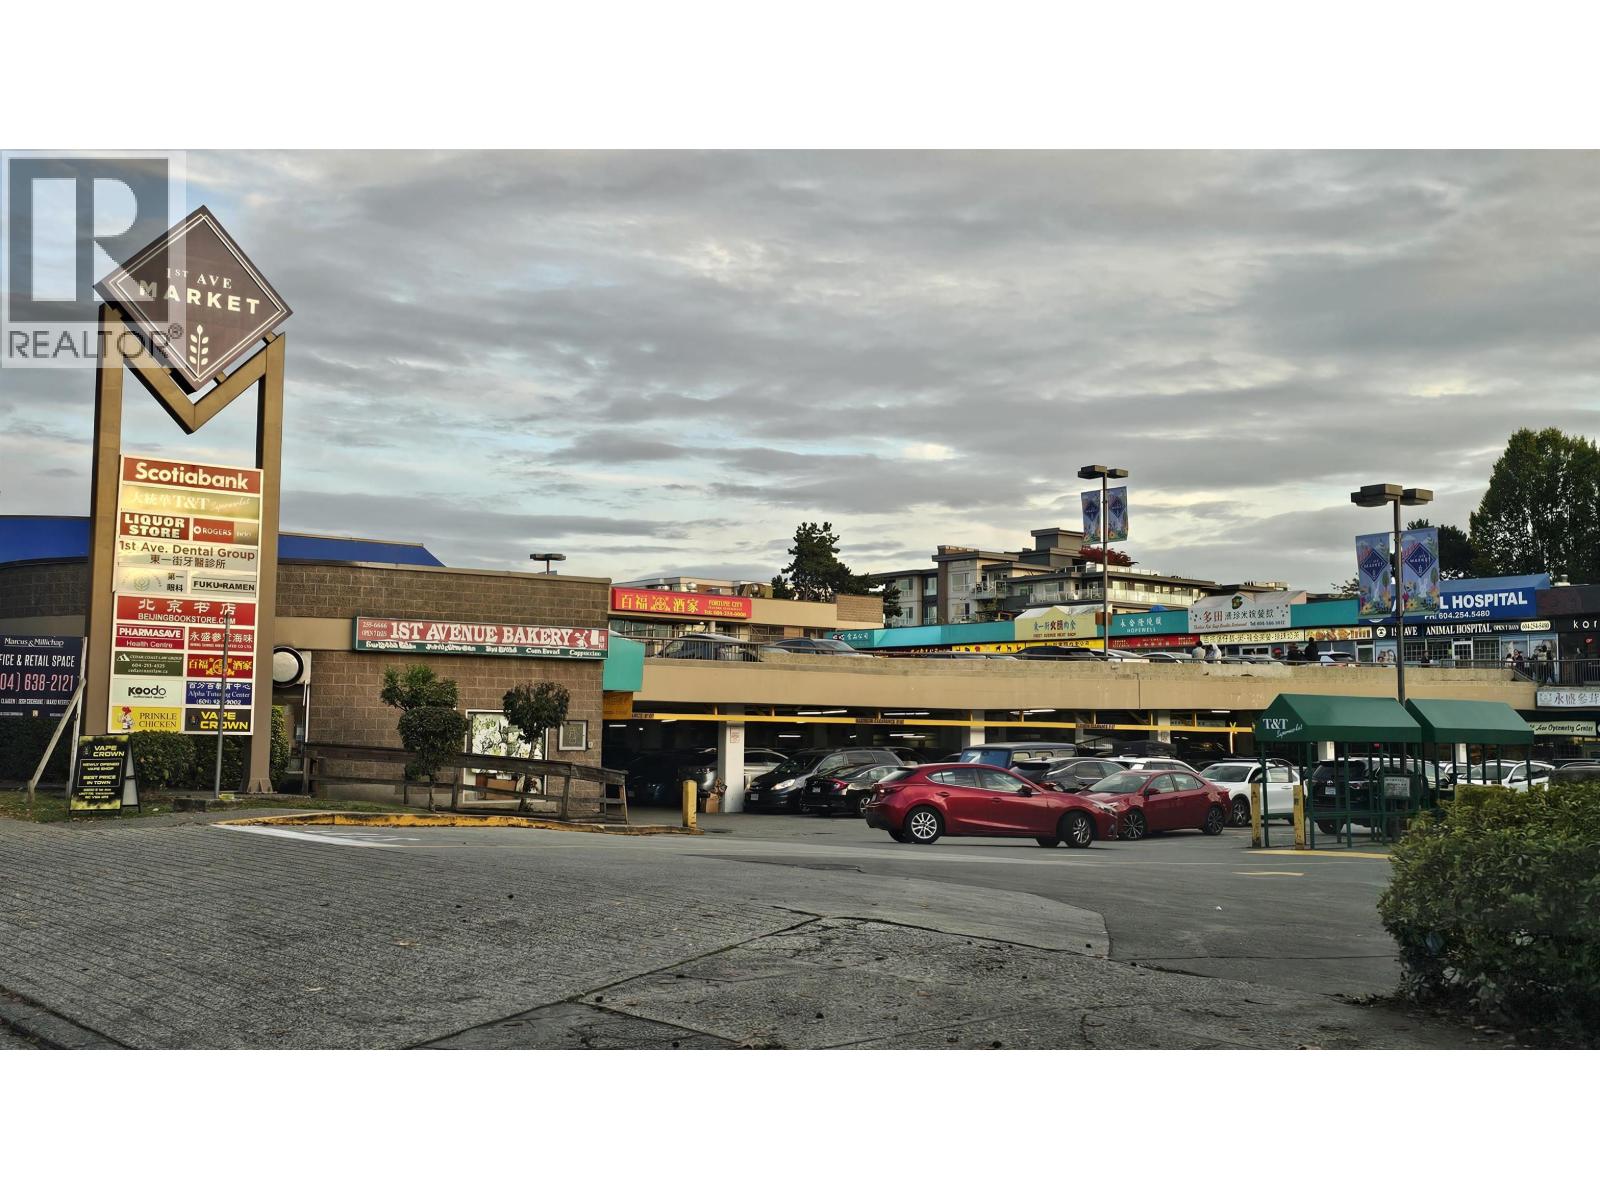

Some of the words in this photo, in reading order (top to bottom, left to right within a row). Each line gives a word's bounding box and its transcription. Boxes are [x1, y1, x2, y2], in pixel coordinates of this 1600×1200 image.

[197, 273, 232, 289] AVE
[139, 279, 260, 315] MARKET
[135, 461, 249, 490] Scotiabank
[172, 495, 210, 510] T&T
[124, 513, 185, 529] LIQUOR
[129, 525, 180, 539] STORE
[202, 528, 232, 537] ROGERS
[119, 540, 136, 551] 1st
[141, 542, 168, 554] Ave.
[172, 544, 213, 557] Dental
[217, 548, 255, 561] Group
[1452, 591, 1528, 610] HOSPITAL
[1438, 610, 1490, 620] 604.254.5480
[119, 627, 181, 639] PHARMASAVE
[390, 622, 424, 640] 1ST
[425, 623, 498, 643] AVENUE
[502, 627, 573, 646] BAKERY
[1403, 626, 1418, 637] AVE
[1426, 626, 1456, 636] ANIMAL
[1456, 623, 1492, 635] HOSPITAL
[126, 640, 149, 648] Health
[17, 655, 22, 666] &
[25, 655, 50, 667] RETAIL
[52, 656, 75, 668] SPACE
[24, 673, 74, 691] 638-2121
[139, 712, 177, 720] PRINKLE
[138, 720, 177, 728] CHICKEN
[1262, 718, 1289, 730] T&T
